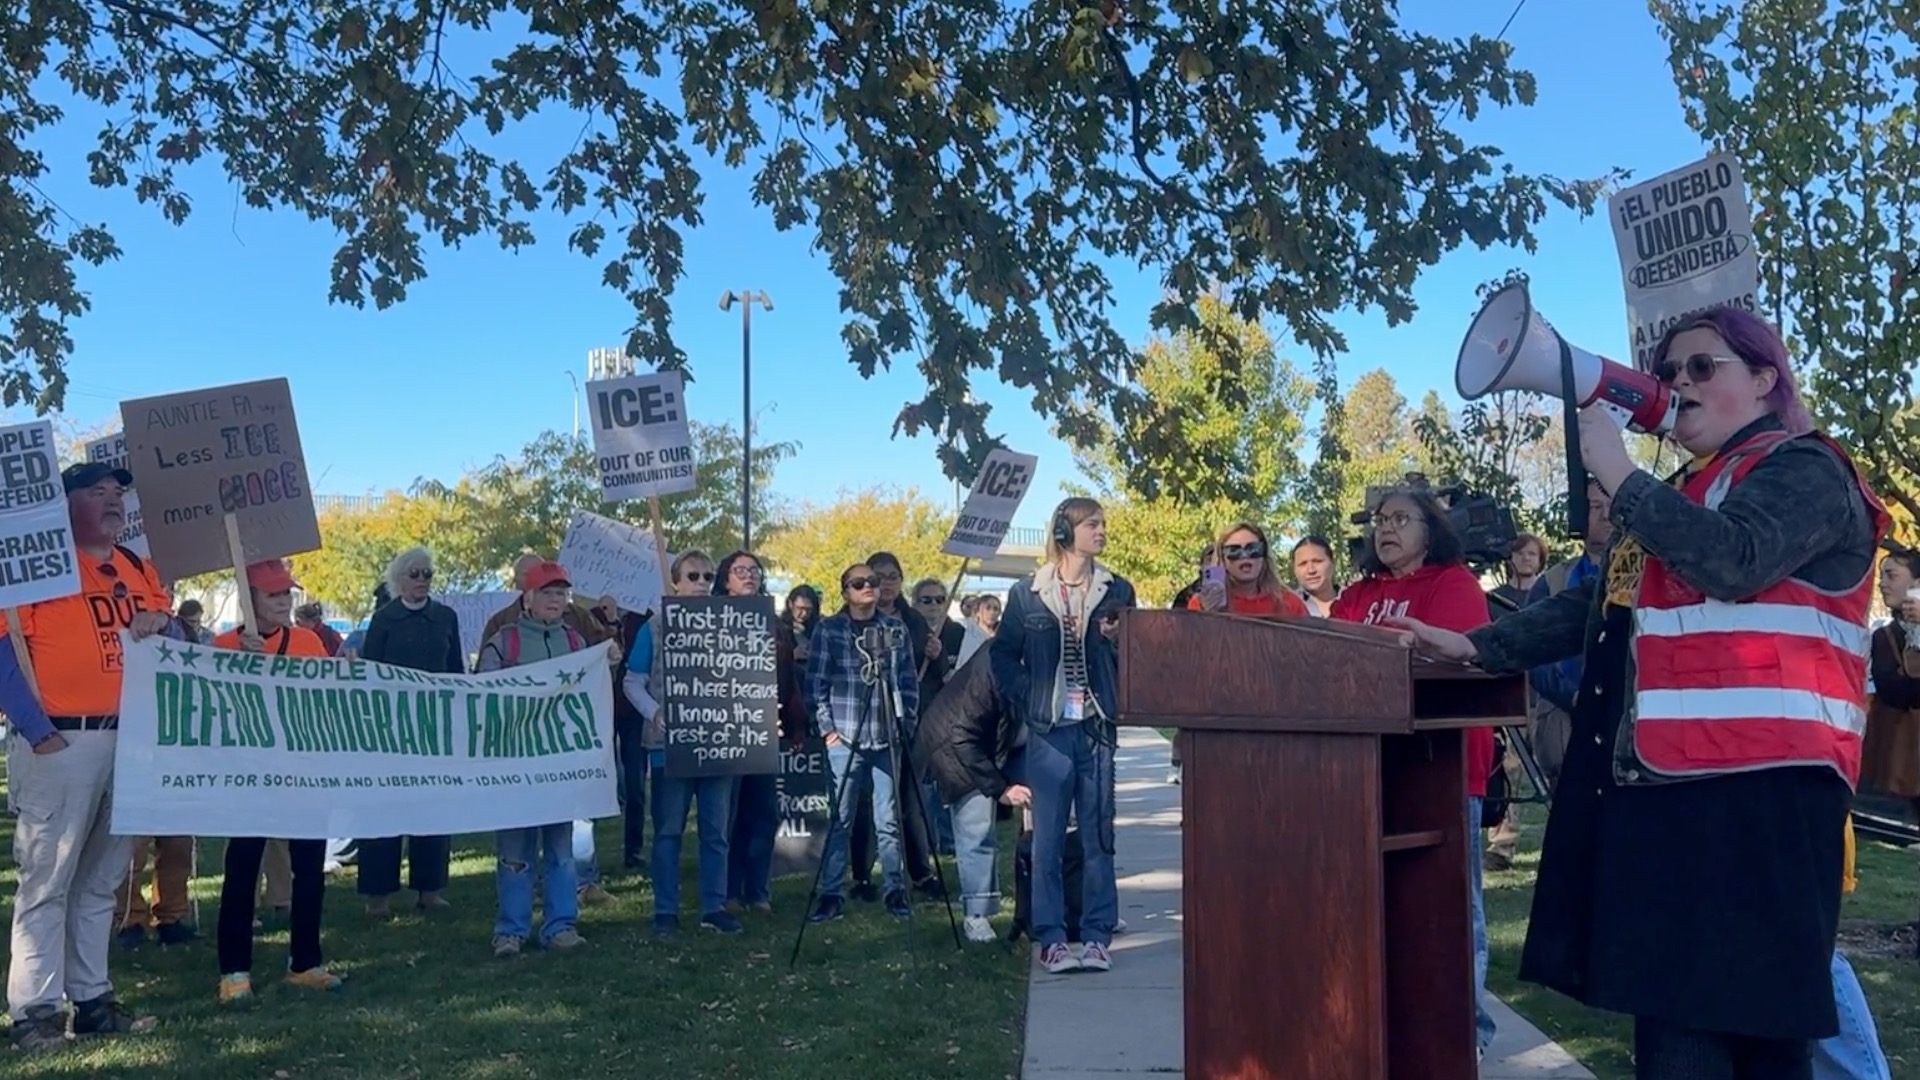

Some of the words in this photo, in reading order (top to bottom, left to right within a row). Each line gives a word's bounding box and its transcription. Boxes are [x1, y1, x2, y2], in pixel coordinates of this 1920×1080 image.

[1619, 195, 1650, 230] ¡EL
[1652, 162, 1732, 212] PUEBLO
[1634, 196, 1727, 261] UNIDO
[1635, 230, 1740, 288] DEFENDERÁ
[1635, 325, 1647, 346] A
[147, 400, 220, 429] AUNTIE
[597, 385, 677, 430] ICE:
[154, 447, 213, 469] Less
[221, 422, 281, 460] ICE
[601, 454, 630, 472] OUT
[635, 450, 654, 467] OF
[660, 446, 691, 464] OUR
[0, 451, 51, 488] ED
[603, 465, 693, 488] COMMUNITIES!
[978, 460, 1028, 500] ICE:
[164, 504, 214, 525] more
[666, 604, 716, 629] First
[720, 604, 768, 637] they
[665, 632, 715, 649] came
[717, 628, 746, 650] for
[212, 652, 266, 675] THE
[269, 655, 367, 681] PEOPLE
[664, 646, 777, 679] immigrants
[666, 675, 689, 697] I'm
[693, 676, 729, 698] here
[731, 677, 779, 699] because
[155, 671, 276, 749] DEFEND
[275, 685, 455, 757] IMMIGRANT
[466, 691, 603, 758] FAMILIES!
[668, 702, 673, 723] I
[678, 702, 729, 723] know
[733, 702, 764, 723] the
[669, 724, 708, 745] rest
[711, 722, 736, 744] of
[738, 724, 768, 746] the
[693, 746, 747, 768] poem
[162, 774, 218, 788] PARTY
[224, 774, 258, 788] FOR
[263, 773, 340, 788] SOCIALISM
[345, 776, 373, 788] AND
[378, 774, 463, 788] LIBERATION
[475, 774, 522, 787] IDAHO
[778, 818, 811, 838] ALL
